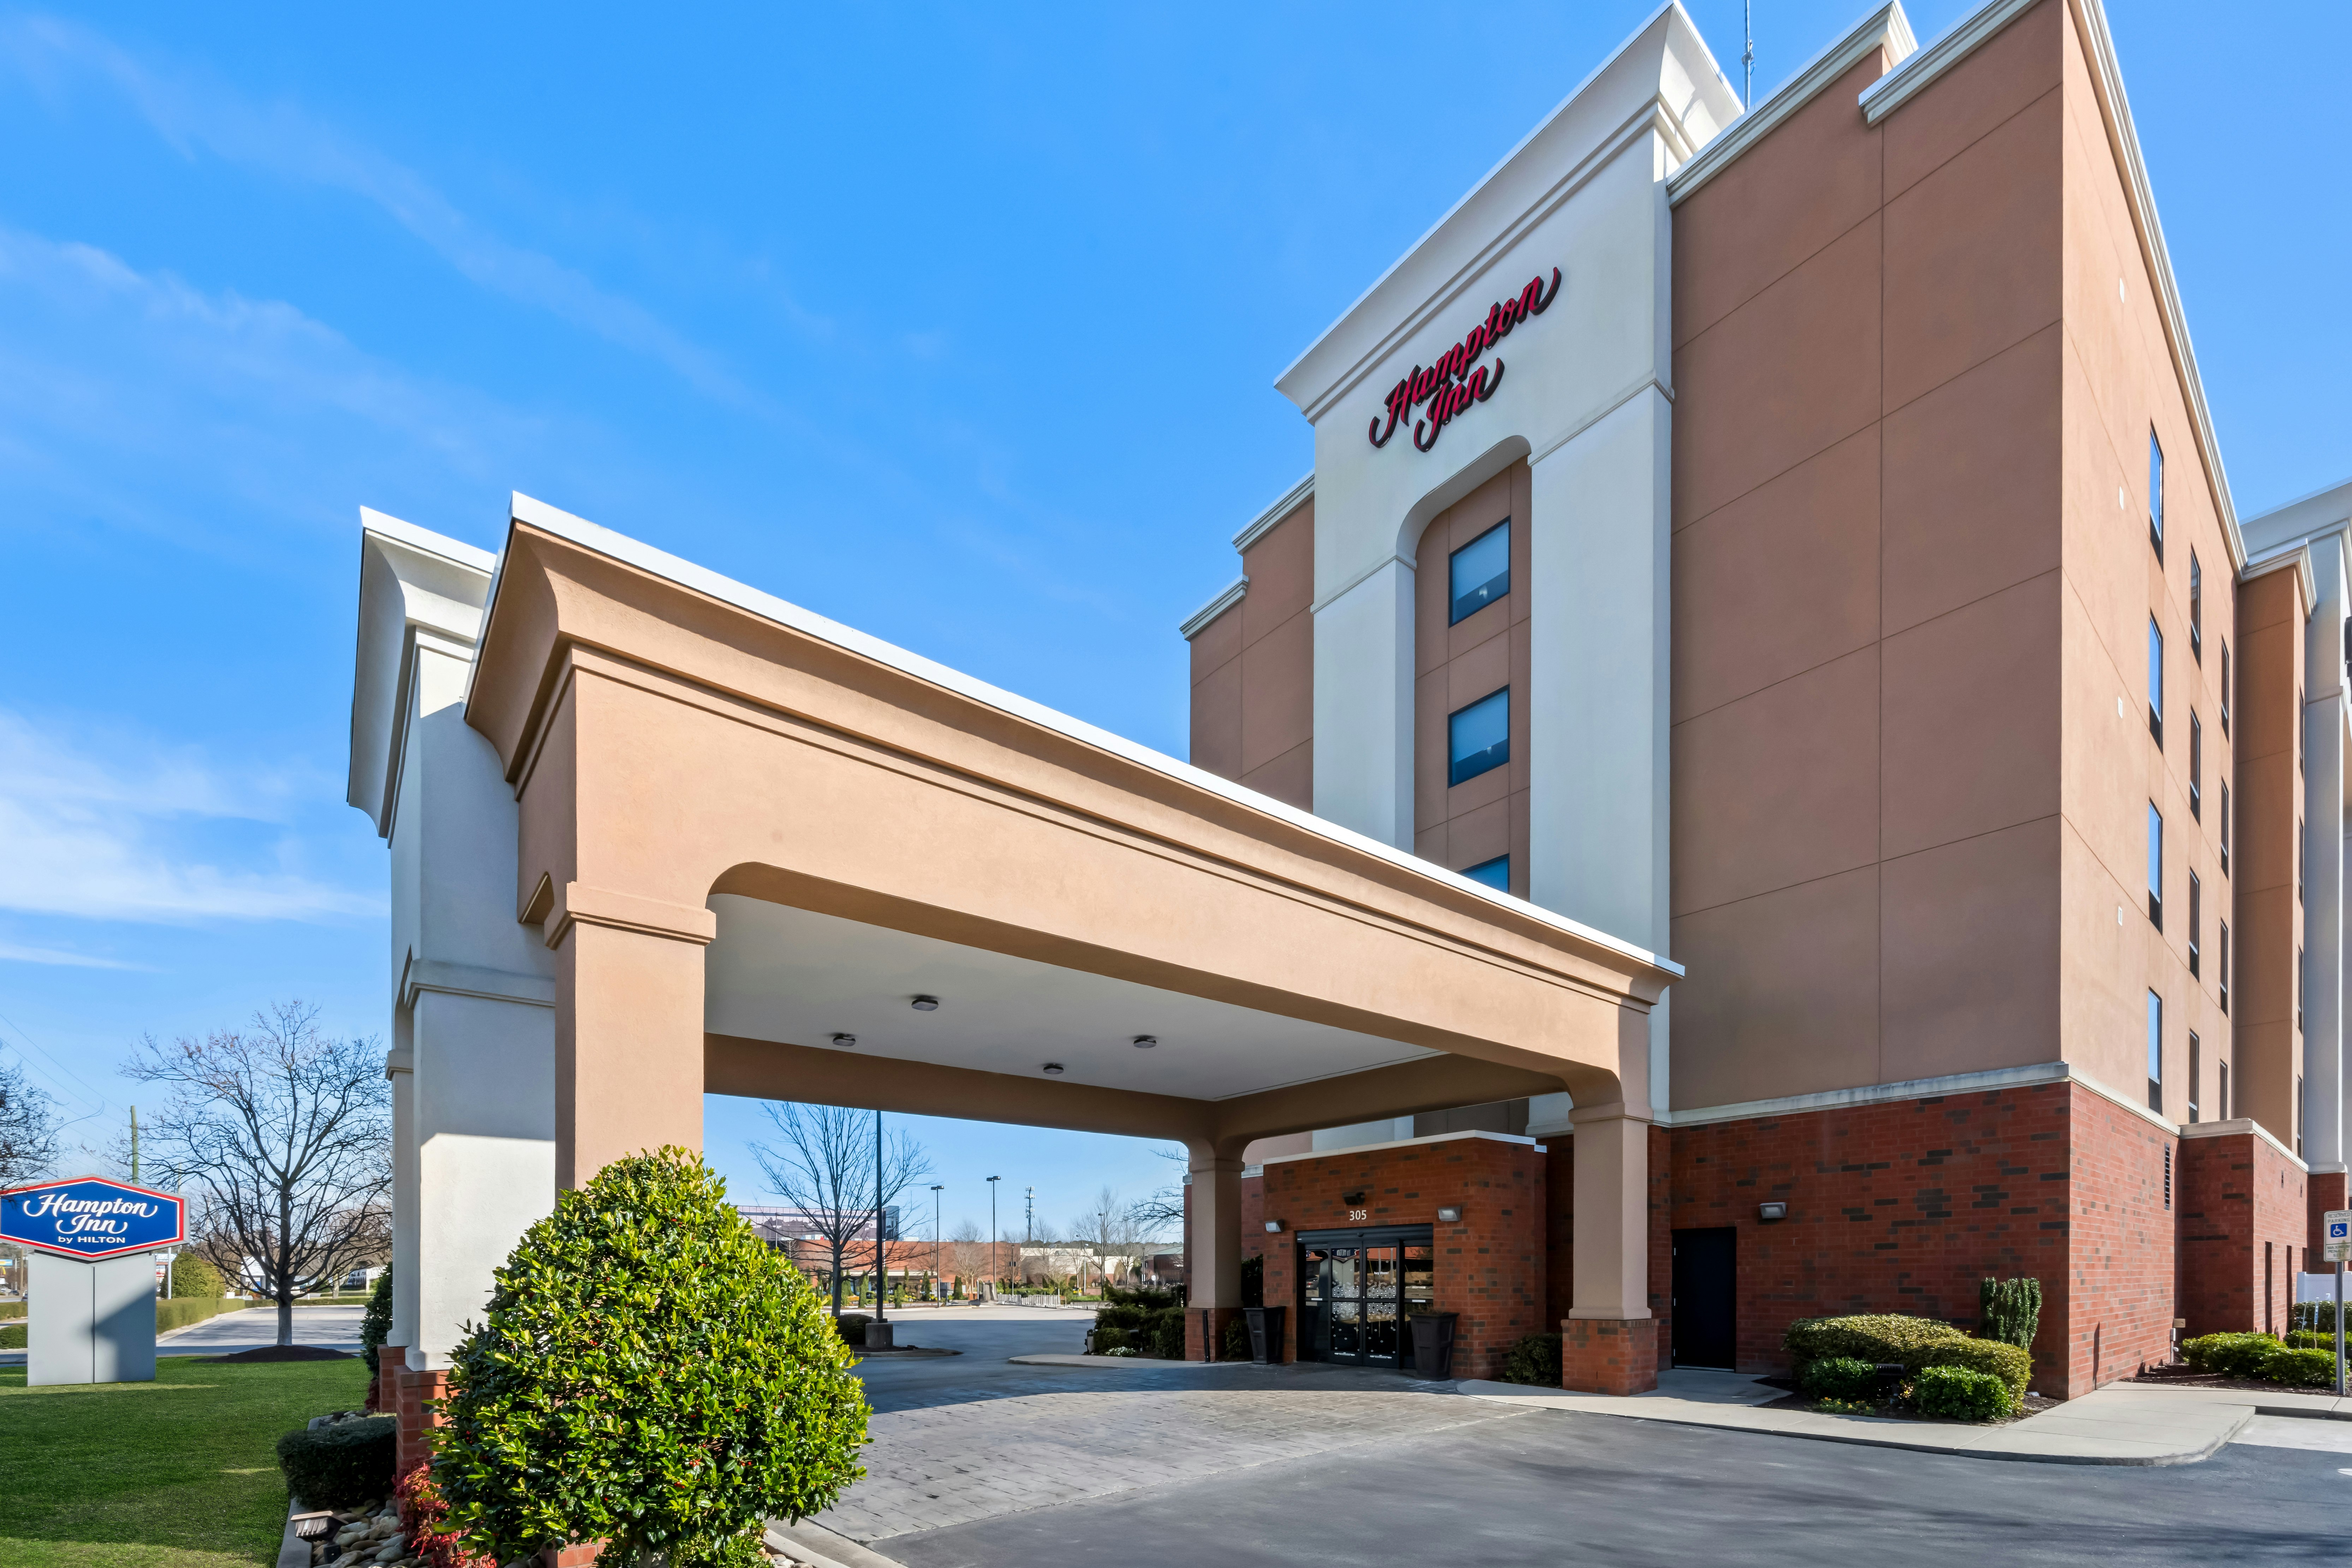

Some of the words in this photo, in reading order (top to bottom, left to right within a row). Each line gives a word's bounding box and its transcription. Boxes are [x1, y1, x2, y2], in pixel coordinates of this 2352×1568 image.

[1369, 267, 1562, 448] Hampton
[1414, 358, 1505, 452] Inn
[23, 1193, 158, 1218] Hampton
[1350, 1210, 1366, 1221] 305
[56, 1214, 128, 1234] Inn
